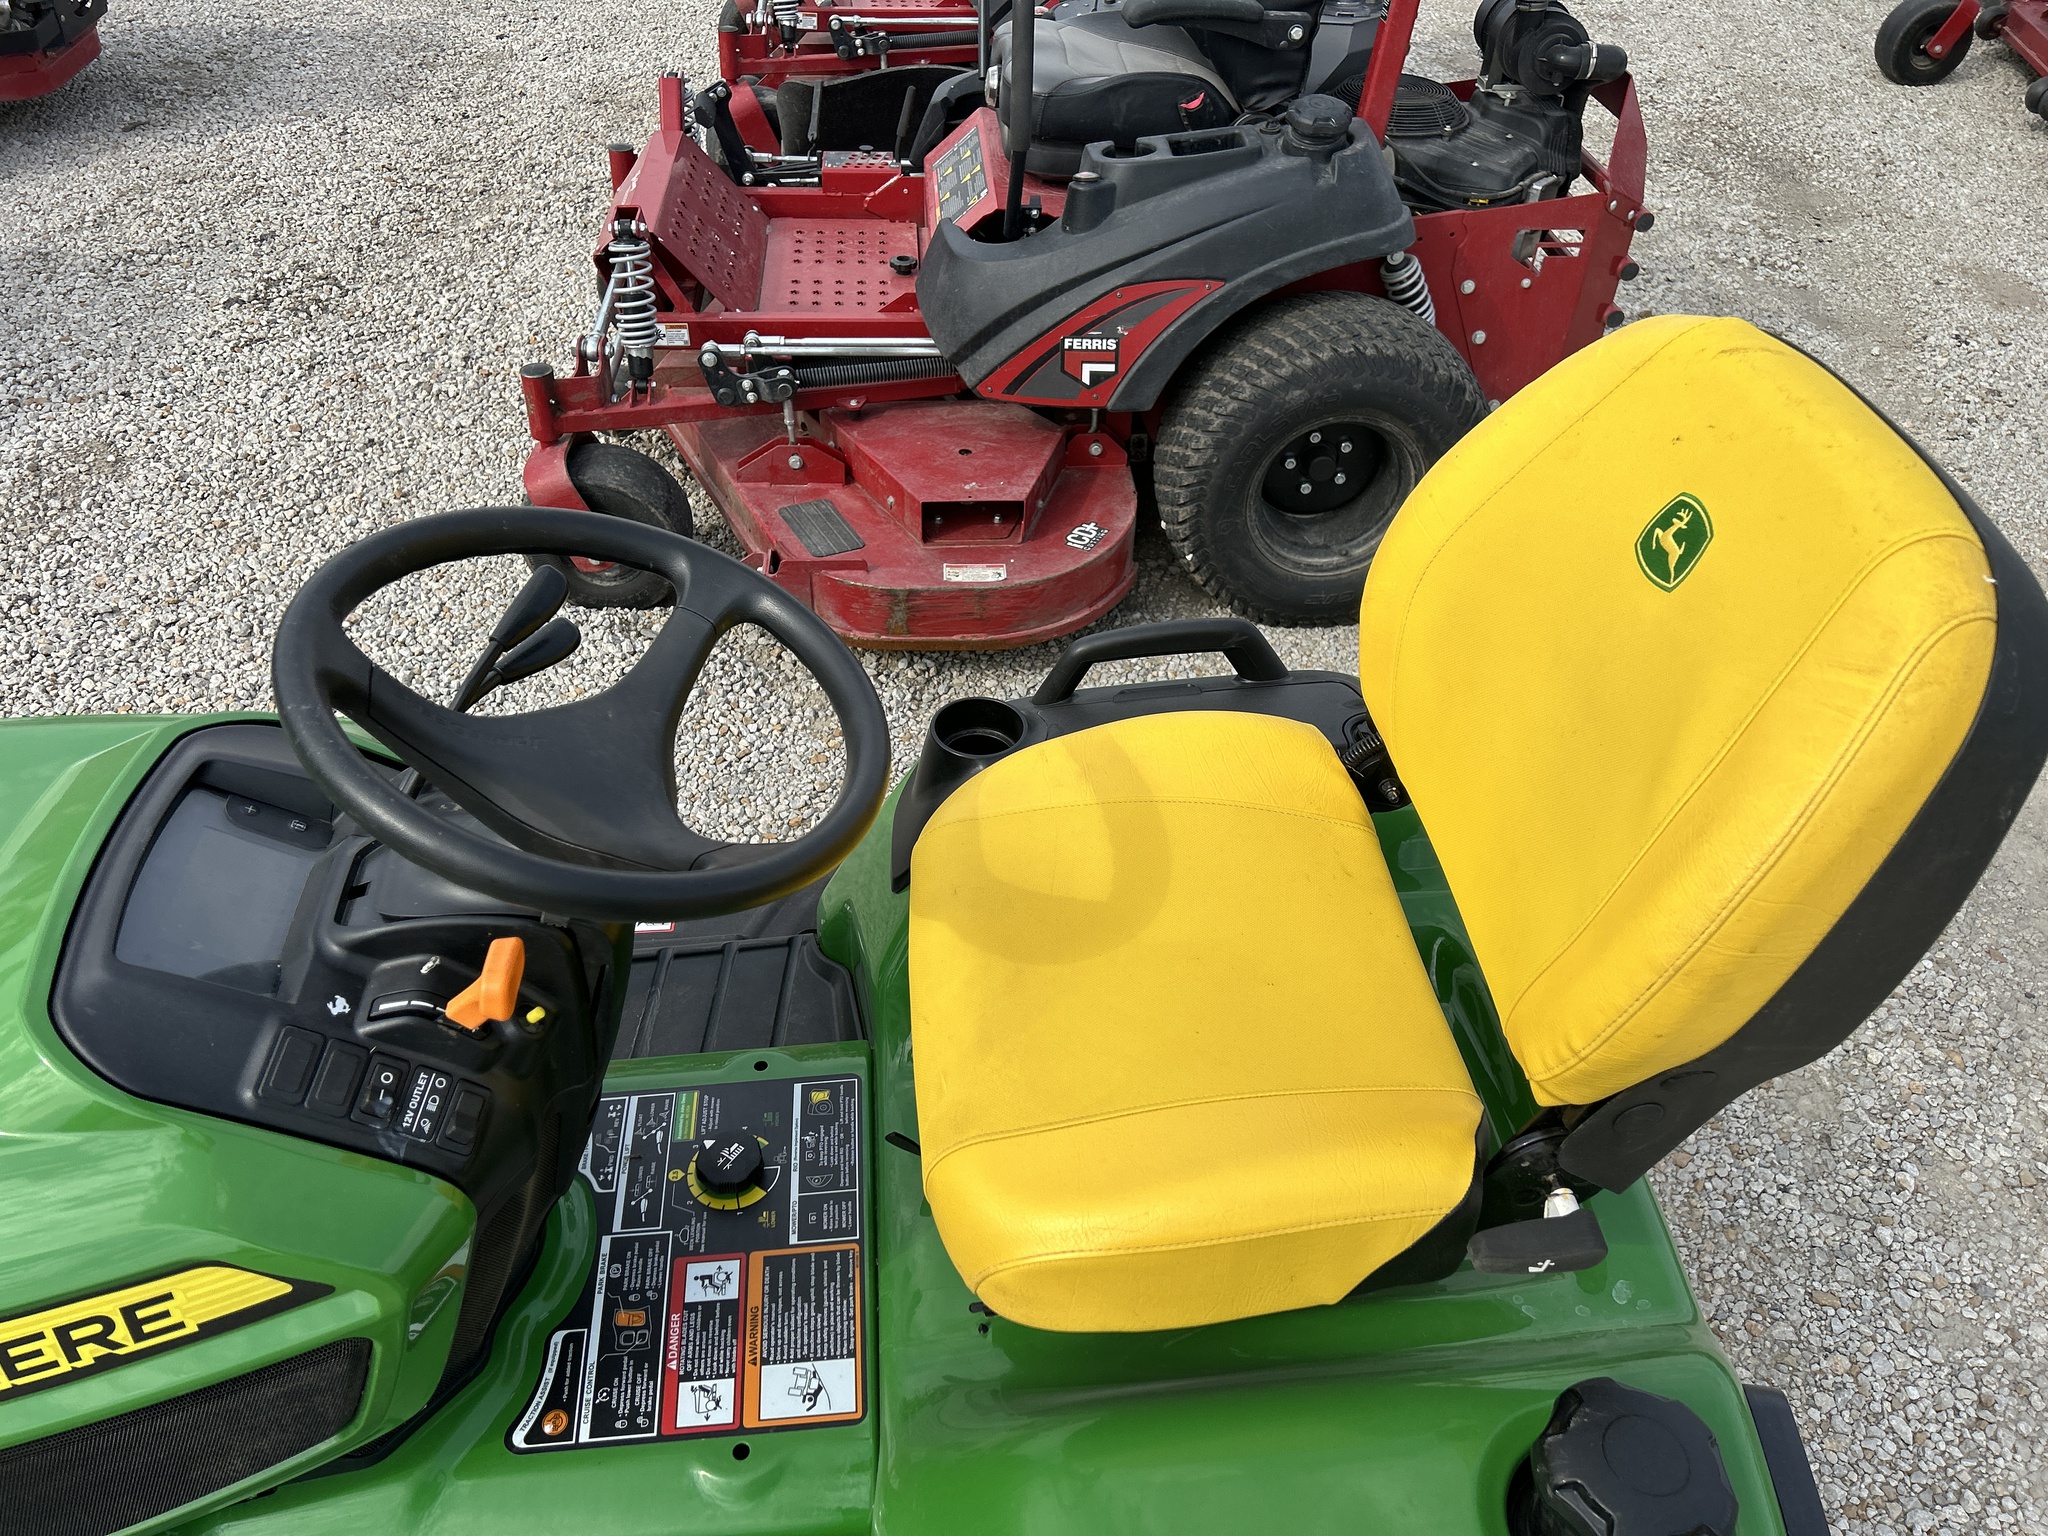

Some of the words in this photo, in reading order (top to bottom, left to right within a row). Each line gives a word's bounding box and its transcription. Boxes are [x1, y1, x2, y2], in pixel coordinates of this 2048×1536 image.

[1064, 338, 1117, 351] FERRIS
[403, 1110, 414, 1127] 12V
[409, 1072, 428, 1109] OUTLET
[599, 1252, 607, 1274] BRAKE
[764, 1285, 769, 1293] OR
[668, 1313, 681, 1358] DANGER
[749, 1306, 759, 1357] WARNING
[585, 1361, 595, 1395] CONTROL
[613, 1377, 619, 1386] ON
[519, 1401, 542, 1431] TRACTION
[538, 1377, 551, 1399] ASSIST
[582, 1397, 592, 1424] CRUISE
